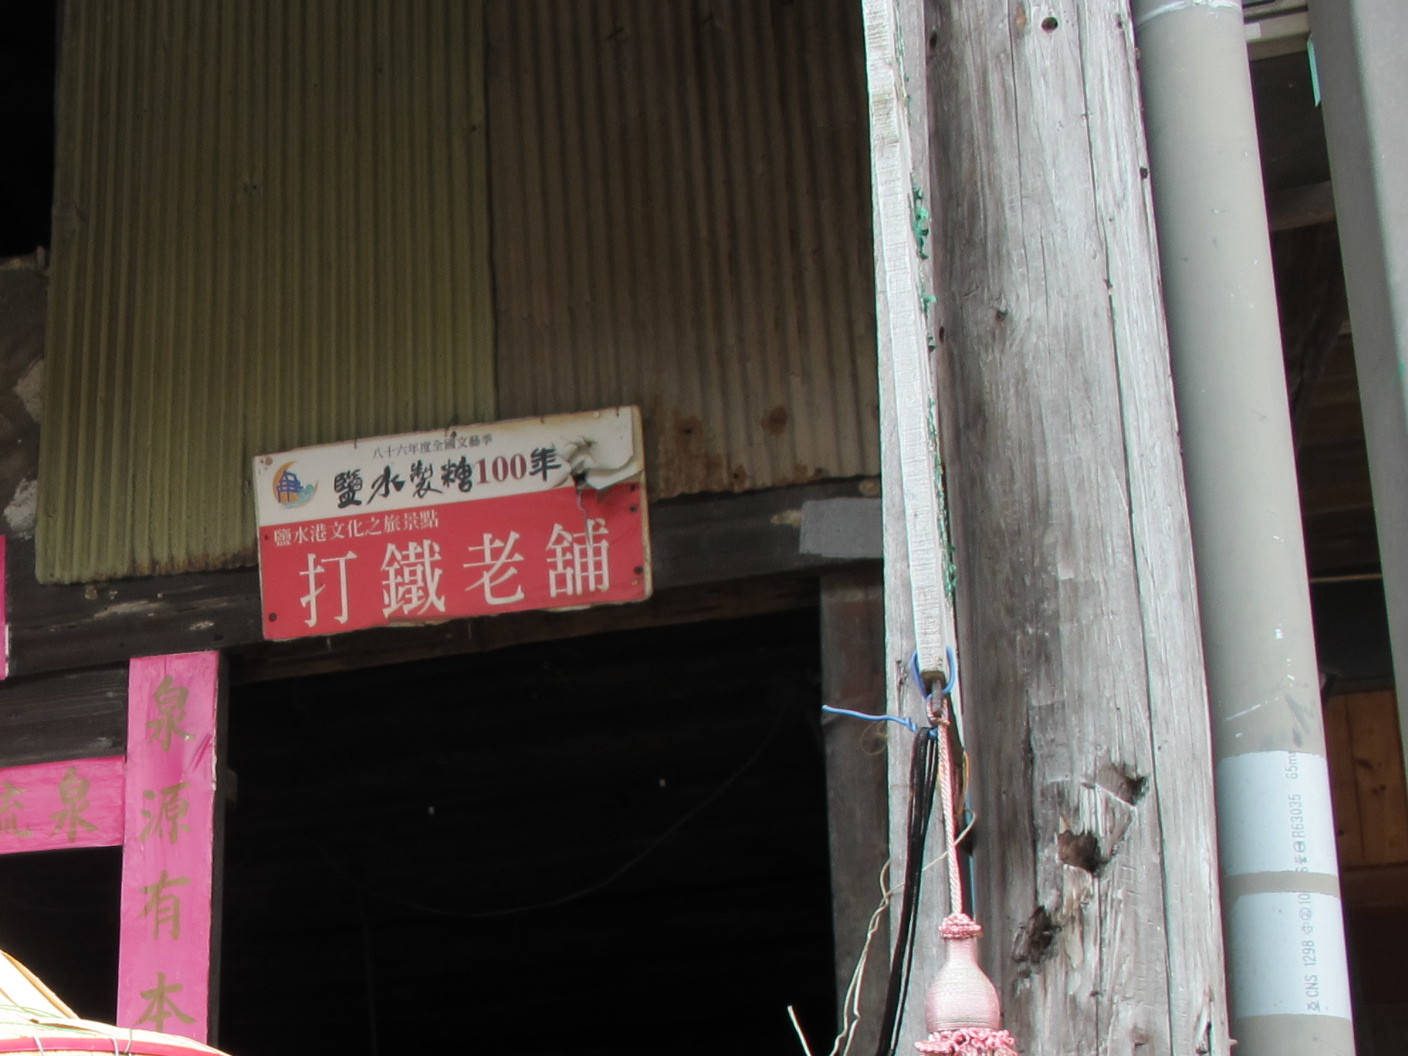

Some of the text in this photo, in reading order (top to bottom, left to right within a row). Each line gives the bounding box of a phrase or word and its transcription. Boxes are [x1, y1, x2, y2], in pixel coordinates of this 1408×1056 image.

[273, 509, 440, 547] 鹽水港文化之旅景點
[298, 517, 611, 629] 打鐵老舖
[1302, 939, 1316, 968] 1298
[1304, 973, 1320, 998] CNS
